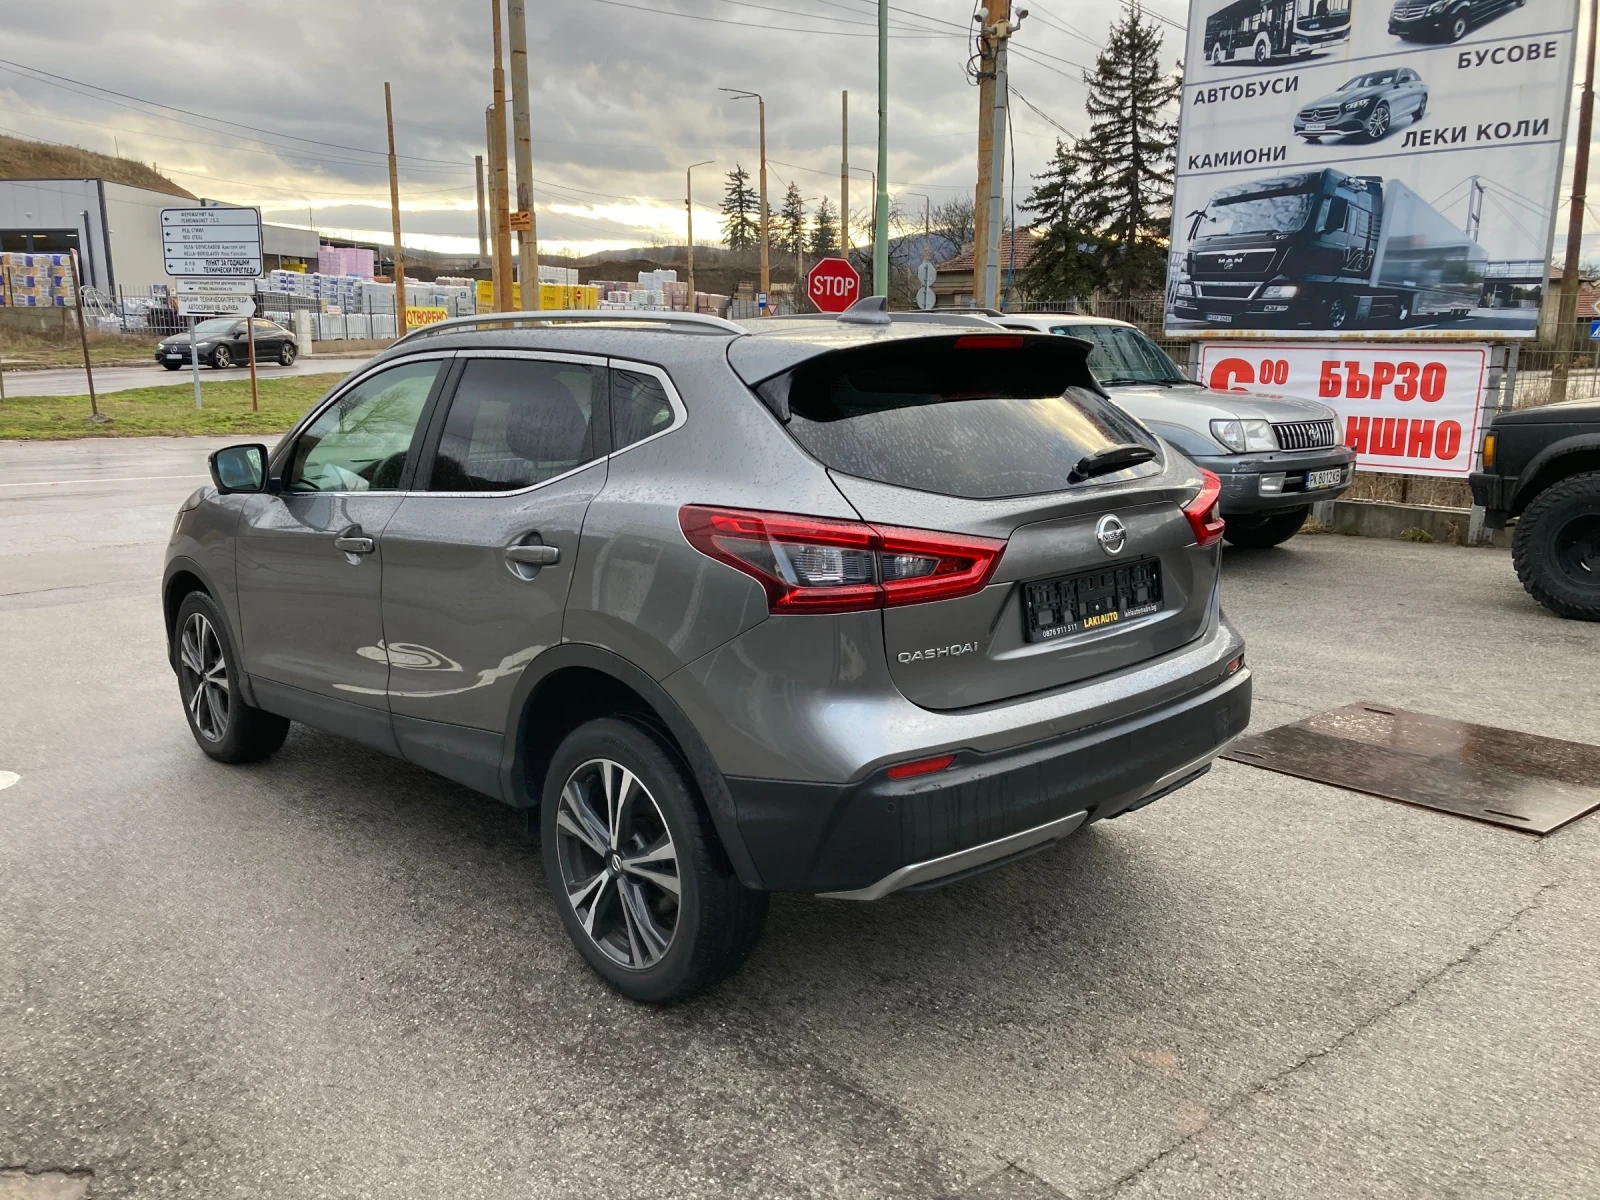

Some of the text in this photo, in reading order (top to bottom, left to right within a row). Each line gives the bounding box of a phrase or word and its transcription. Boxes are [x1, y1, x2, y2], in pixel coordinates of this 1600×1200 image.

[1457, 40, 1558, 69] БУСОВЕ
[1193, 75, 1299, 106] АВТОБУСИ
[1401, 117, 1550, 149] ЛЕКИ КОЛИ
[1187, 145, 1287, 170] КАМИОНИ
[813, 275, 855, 297] STOP
[1318, 360, 1448, 403] БЪРЗО
[1345, 415, 1462, 461] НШНО
[1042, 623, 1078, 638] 0876 911 511
[1083, 611, 1118, 628] LAKI AUTO
[897, 641, 978, 664] QASHQAI
